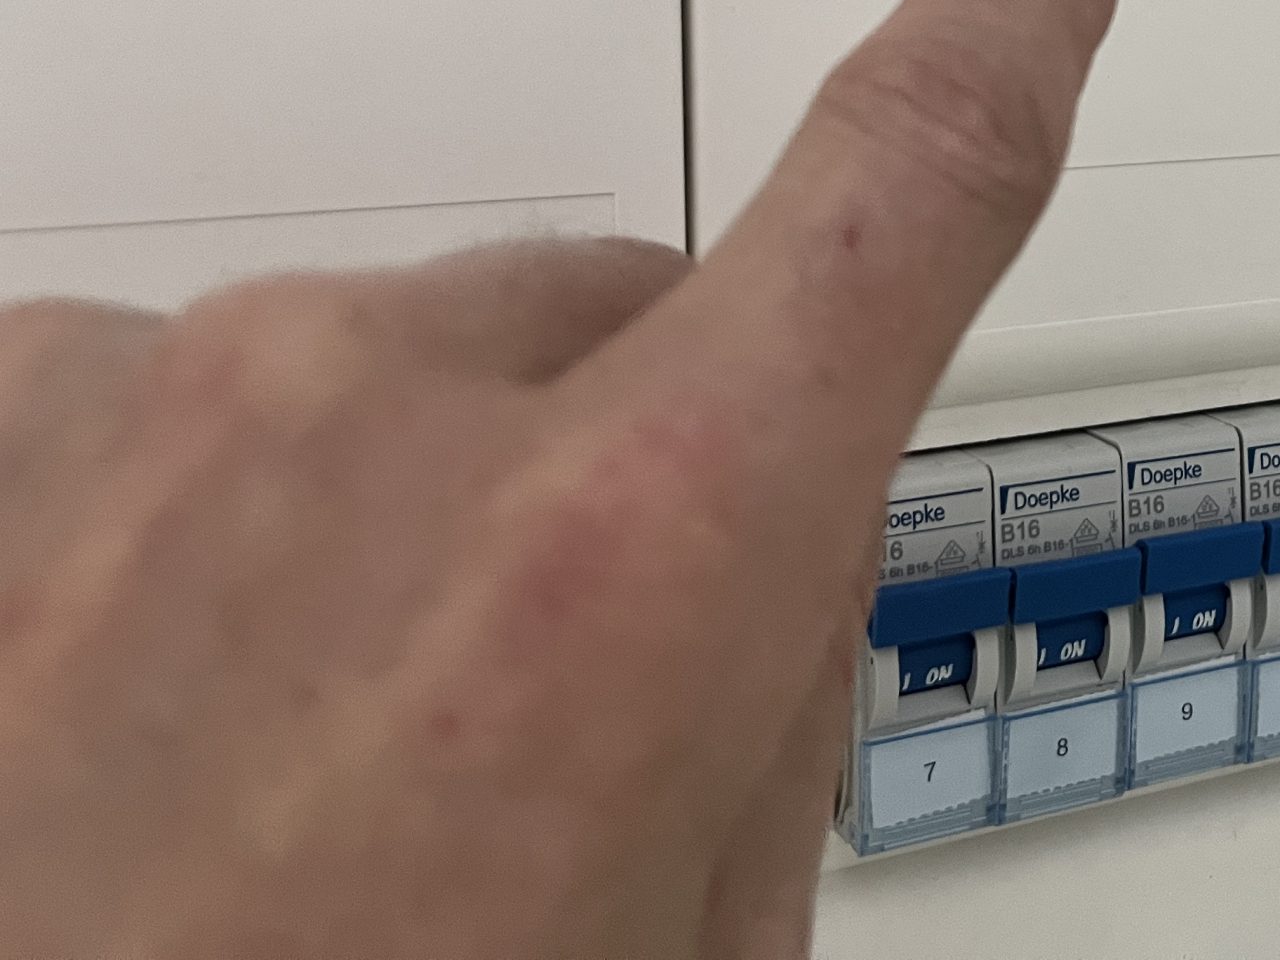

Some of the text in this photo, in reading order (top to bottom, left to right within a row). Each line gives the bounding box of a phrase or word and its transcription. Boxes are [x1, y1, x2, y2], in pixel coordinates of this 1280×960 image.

[1141, 461, 1202, 486] Doepke
[1014, 484, 1080, 510] Doepke
[1129, 494, 1164, 518] B16
[883, 503, 946, 530] oepke
[1001, 519, 1040, 544] B16
[1001, 546, 1025, 560] DLS
[1192, 610, 1217, 630] ON
[1060, 639, 1086, 660] ON
[925, 664, 953, 685] ON
[1181, 702, 1193, 721] 9
[1056, 737, 1069, 756] 8
[923, 761, 936, 782] 7
